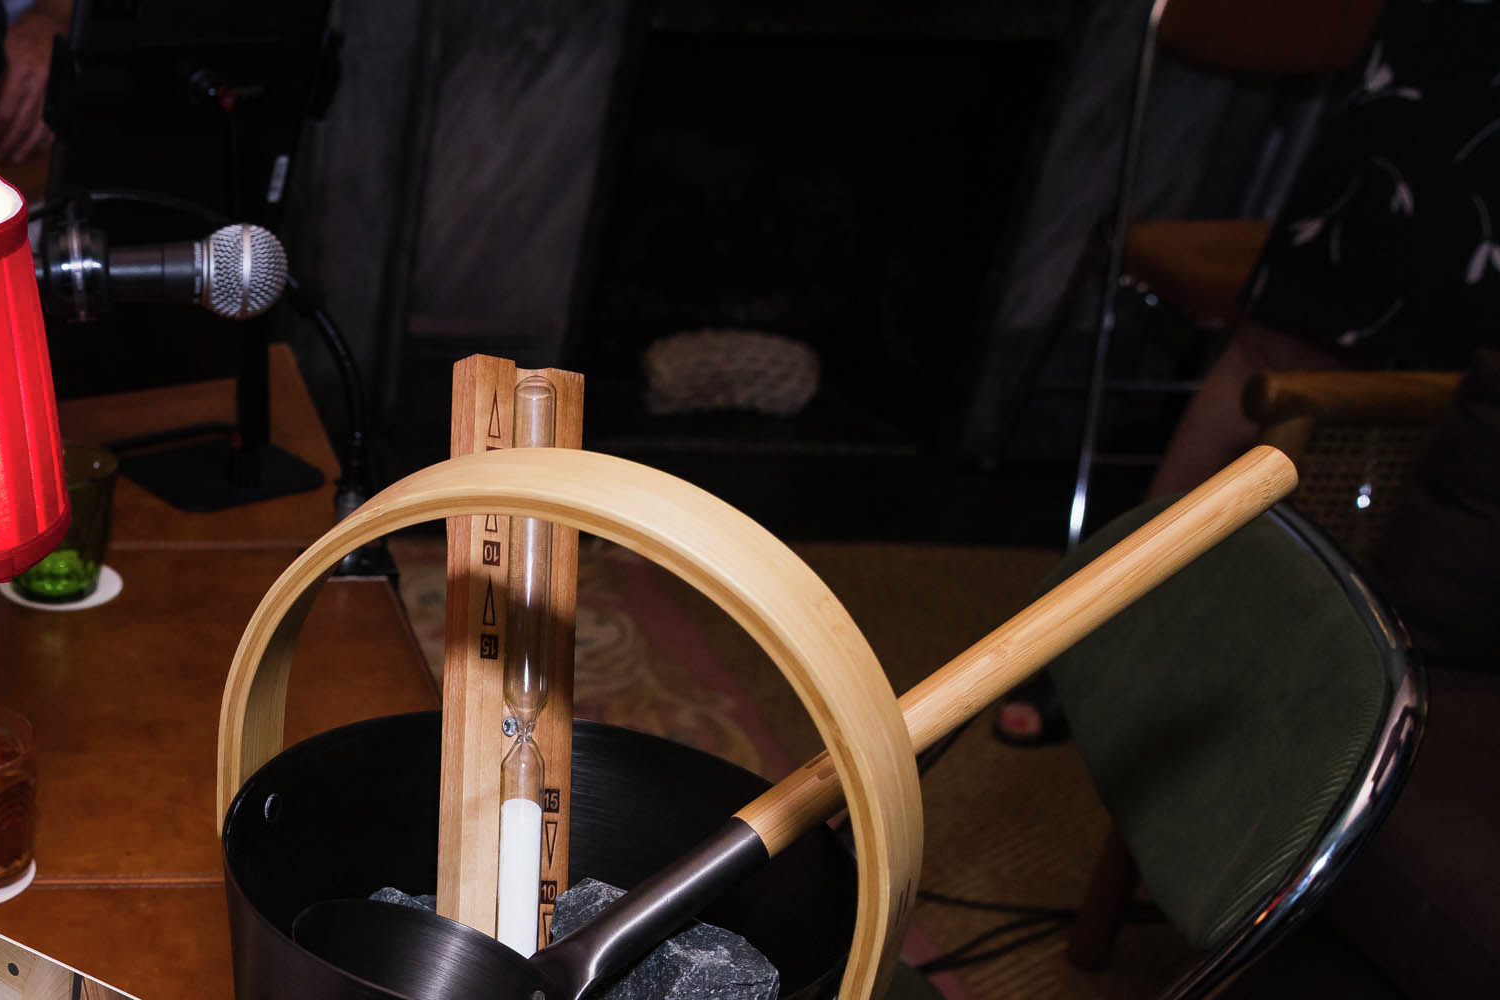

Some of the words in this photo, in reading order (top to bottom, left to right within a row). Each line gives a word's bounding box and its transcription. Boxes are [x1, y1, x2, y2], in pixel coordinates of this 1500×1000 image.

[483, 541, 500, 565] 10
[480, 635, 498, 659] 15
[544, 790, 559, 812] 15
[540, 881, 557, 901] 10
